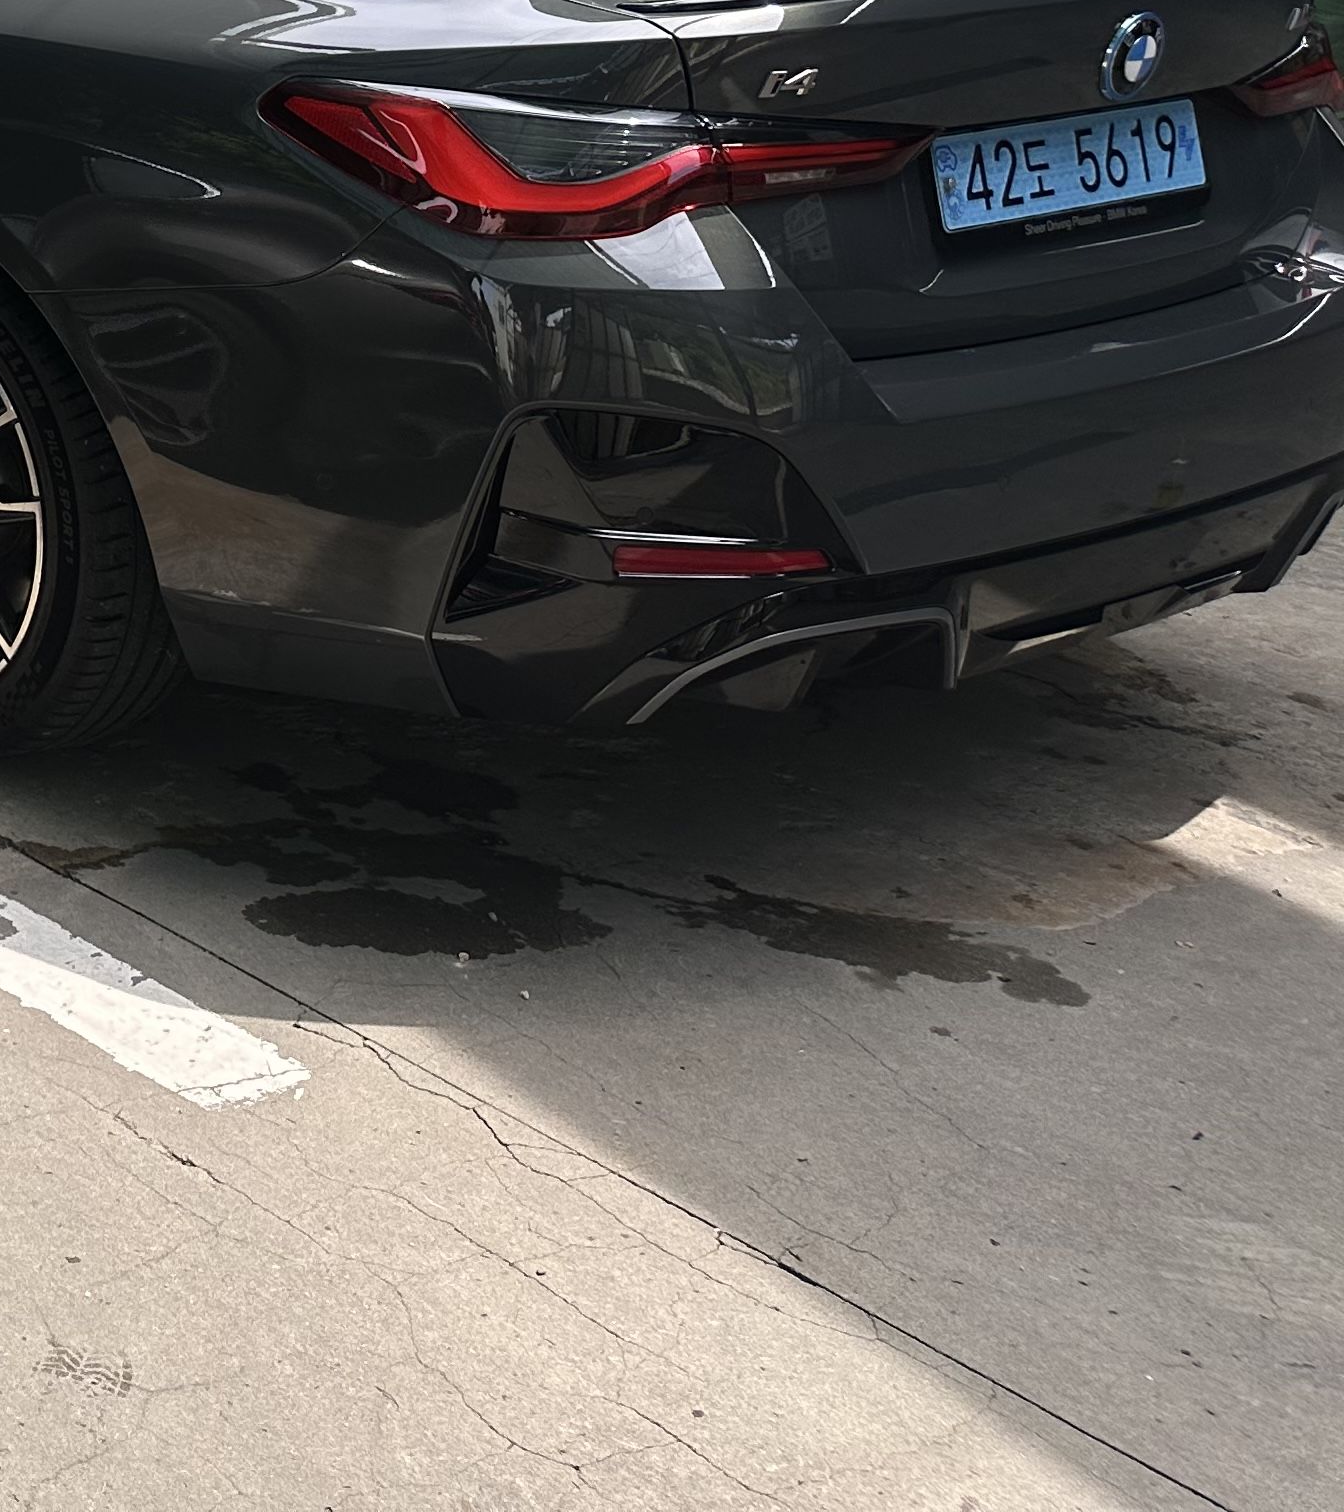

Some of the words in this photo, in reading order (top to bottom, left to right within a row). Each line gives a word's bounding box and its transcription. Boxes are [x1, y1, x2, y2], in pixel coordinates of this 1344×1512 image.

[758, 68, 820, 99] i4
[966, 139, 1056, 211] 42도
[1073, 114, 1177, 194] 5619
[43, 427, 67, 481] PILOT
[57, 488, 75, 552] SPORT
